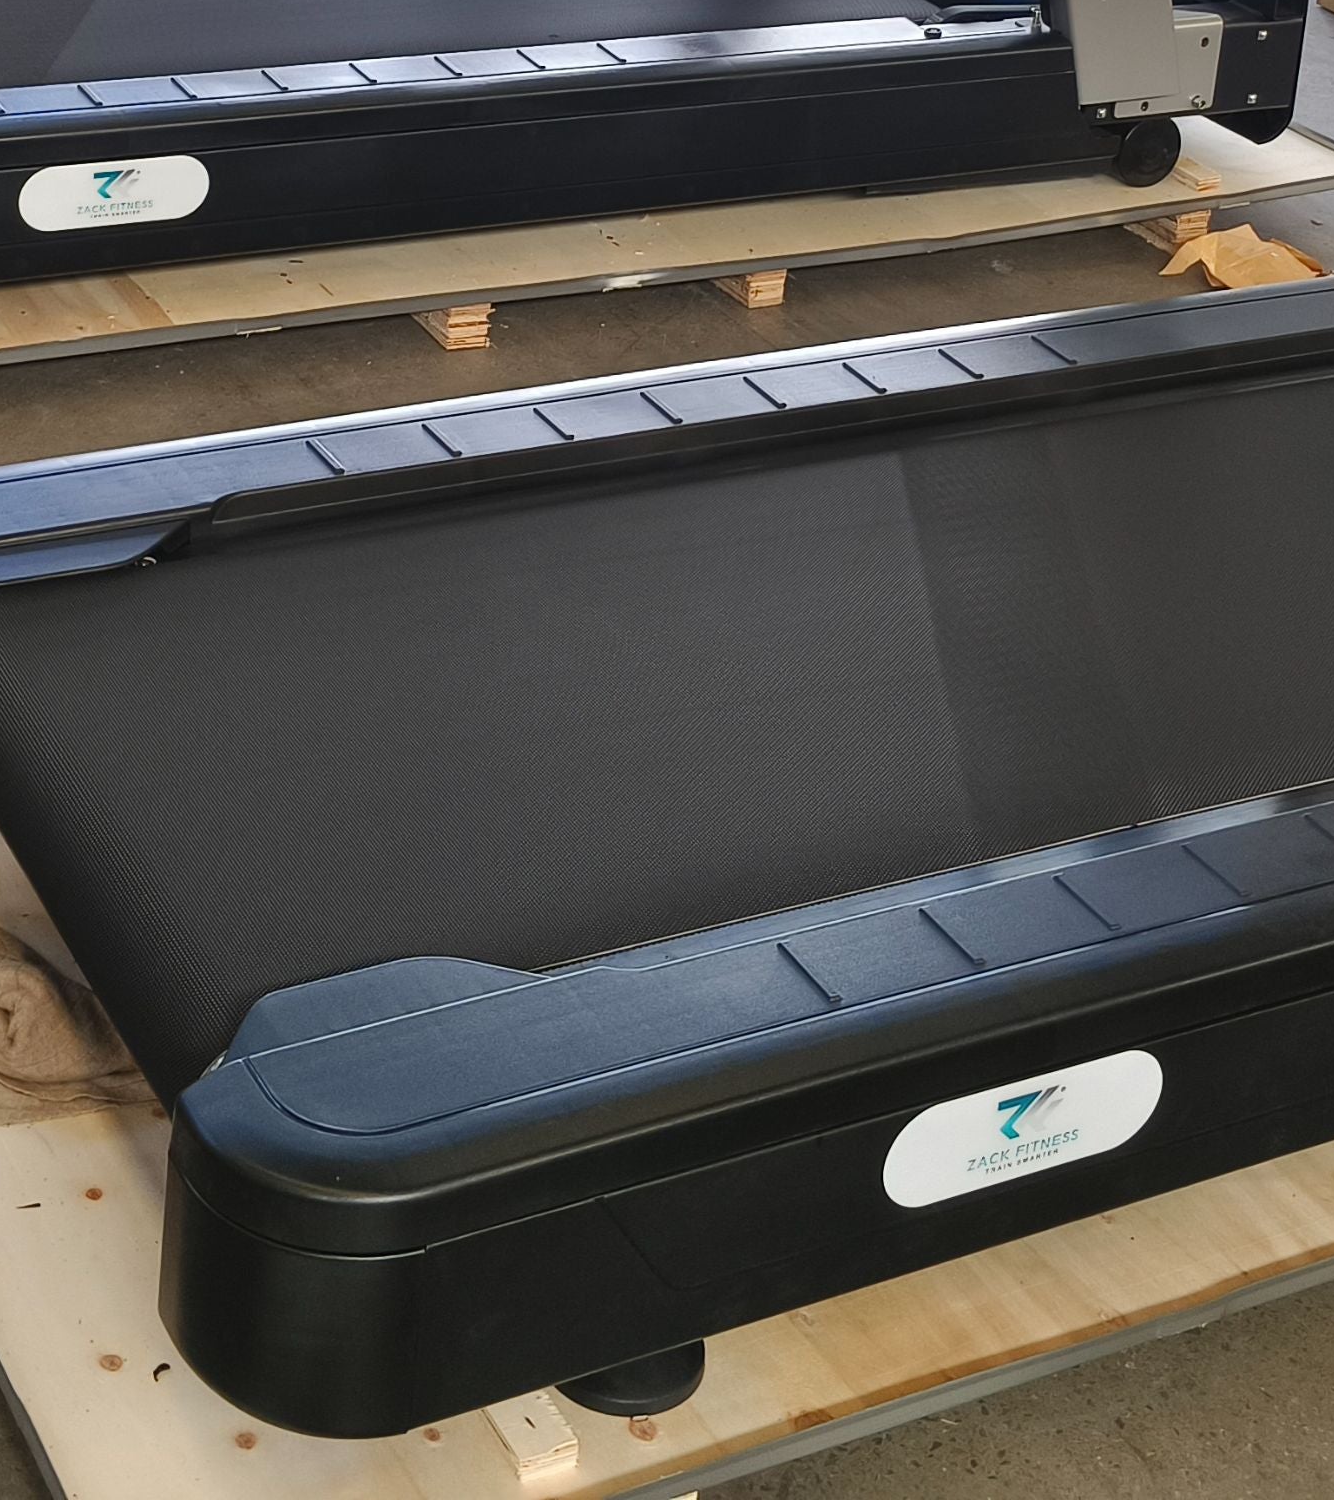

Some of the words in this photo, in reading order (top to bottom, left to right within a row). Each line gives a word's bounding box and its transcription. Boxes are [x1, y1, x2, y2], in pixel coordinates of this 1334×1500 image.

[77, 204, 106, 215] ZACK
[110, 200, 154, 211] FITNESS
[967, 1149, 1010, 1172] ZACK
[1015, 1129, 1080, 1158] FITNESS
[985, 1162, 1013, 1175] TRAIN
